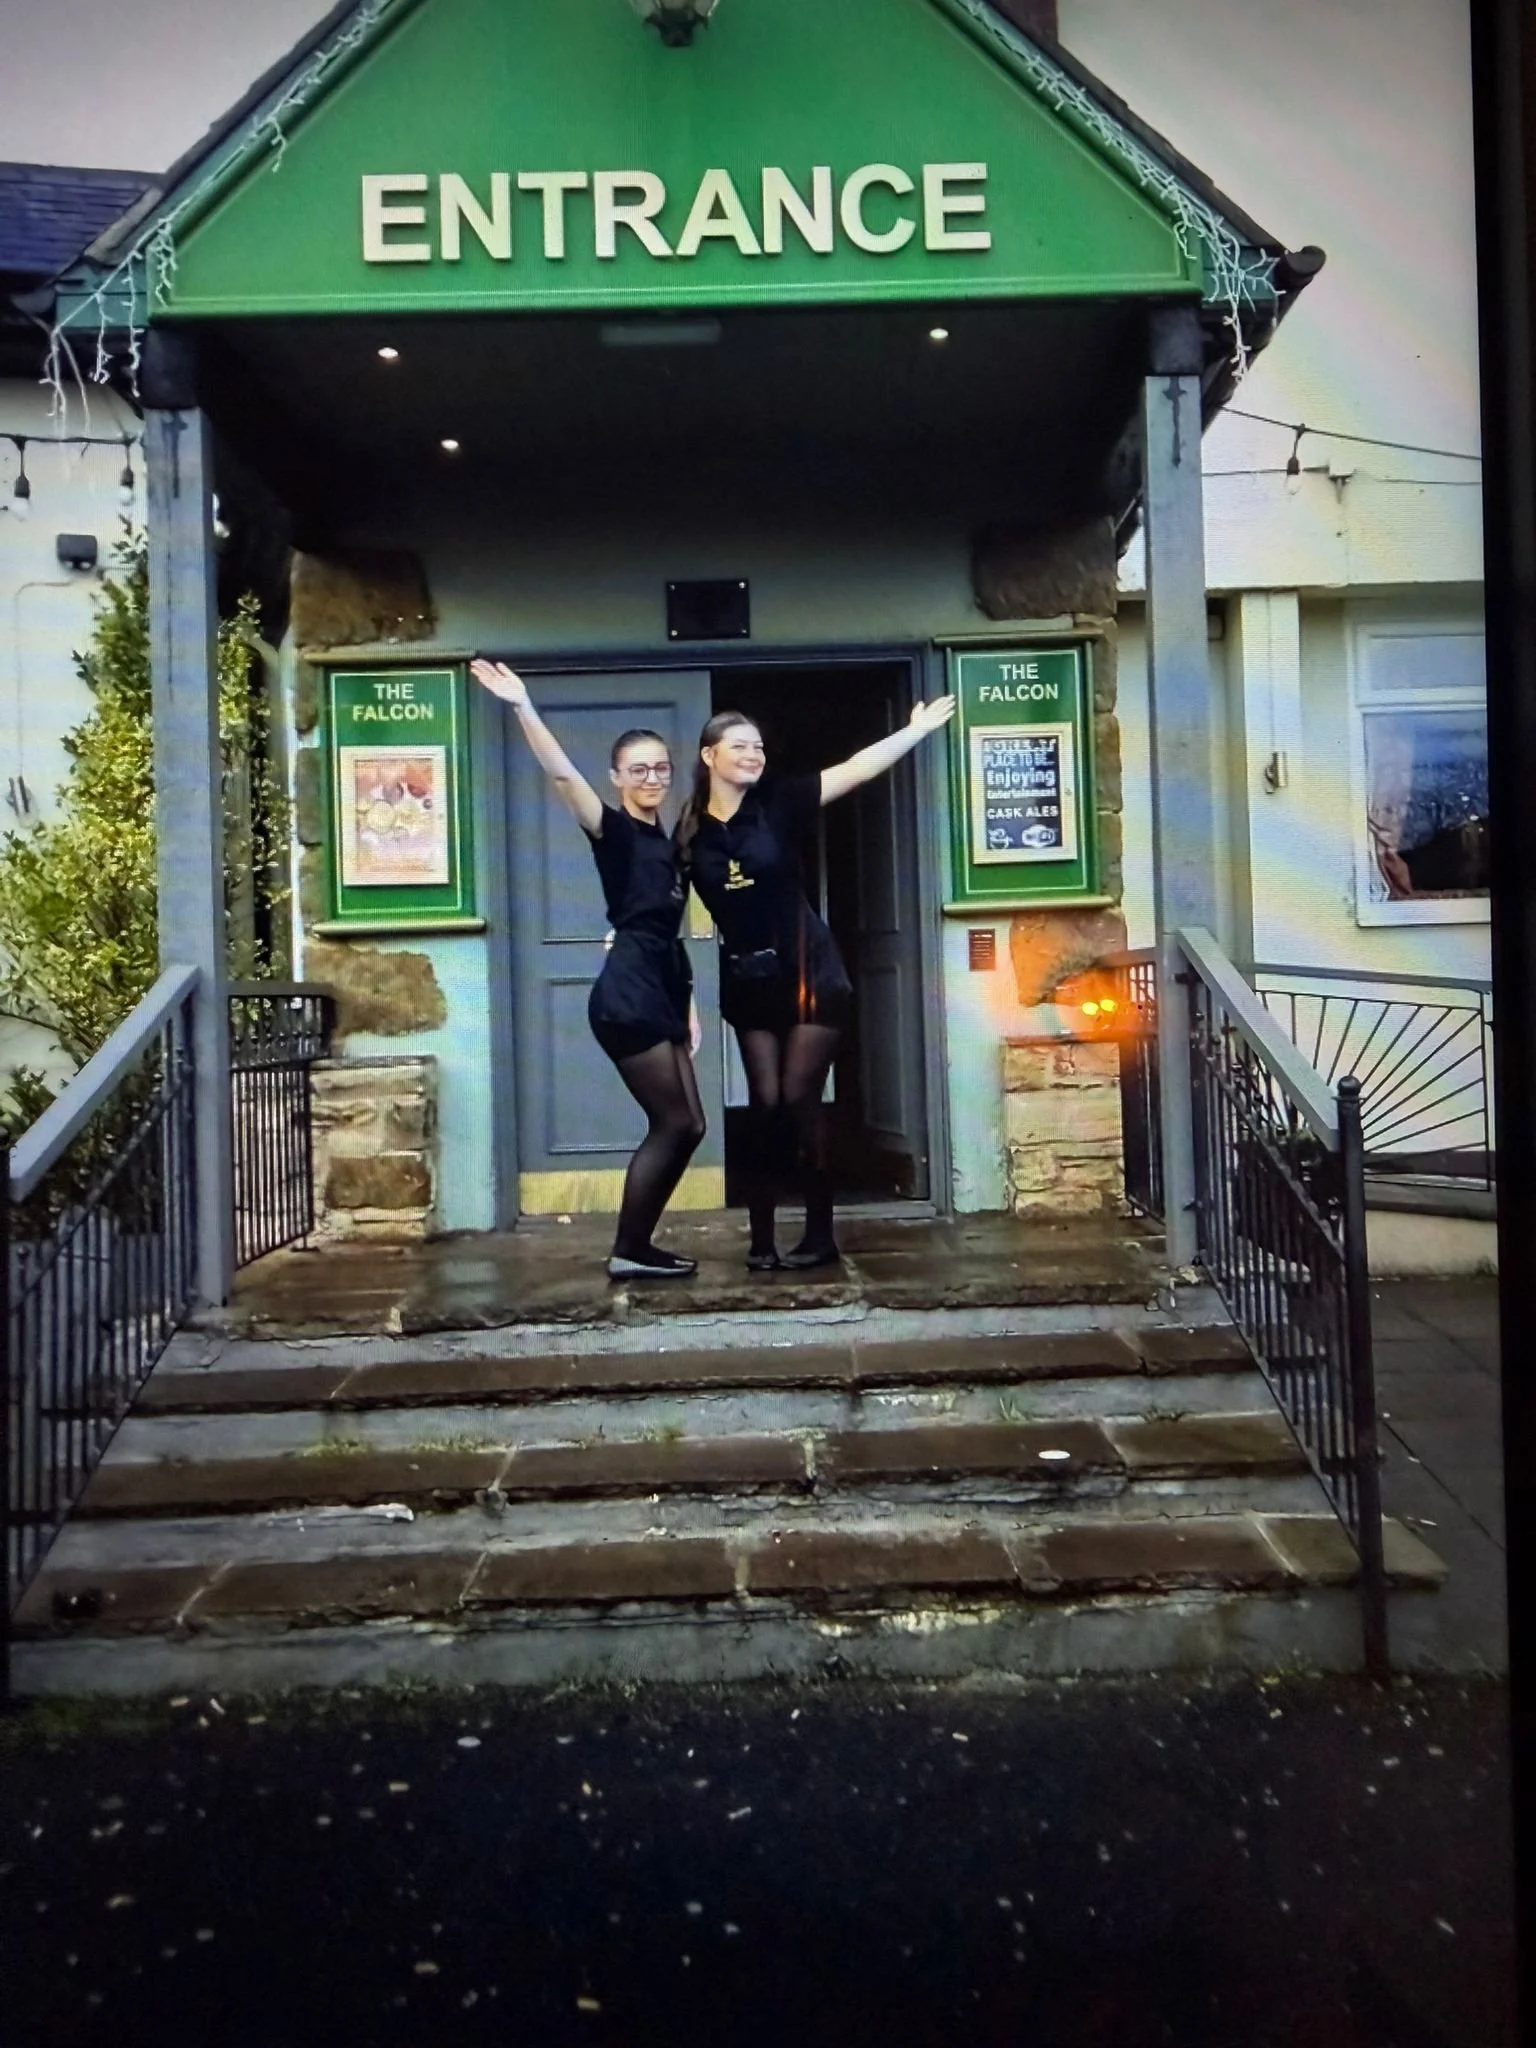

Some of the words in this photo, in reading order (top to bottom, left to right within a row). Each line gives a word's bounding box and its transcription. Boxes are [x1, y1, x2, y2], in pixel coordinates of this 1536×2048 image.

[361, 162, 992, 262] ENTRANCE
[999, 663, 1039, 680] THE
[373, 683, 414, 700] THE
[979, 683, 1058, 702] FALCON
[352, 703, 434, 721] FALCON
[987, 767, 1056, 788] Enjoying
[987, 807, 1023, 819] CASK
[1026, 805, 1058, 817] ALES
